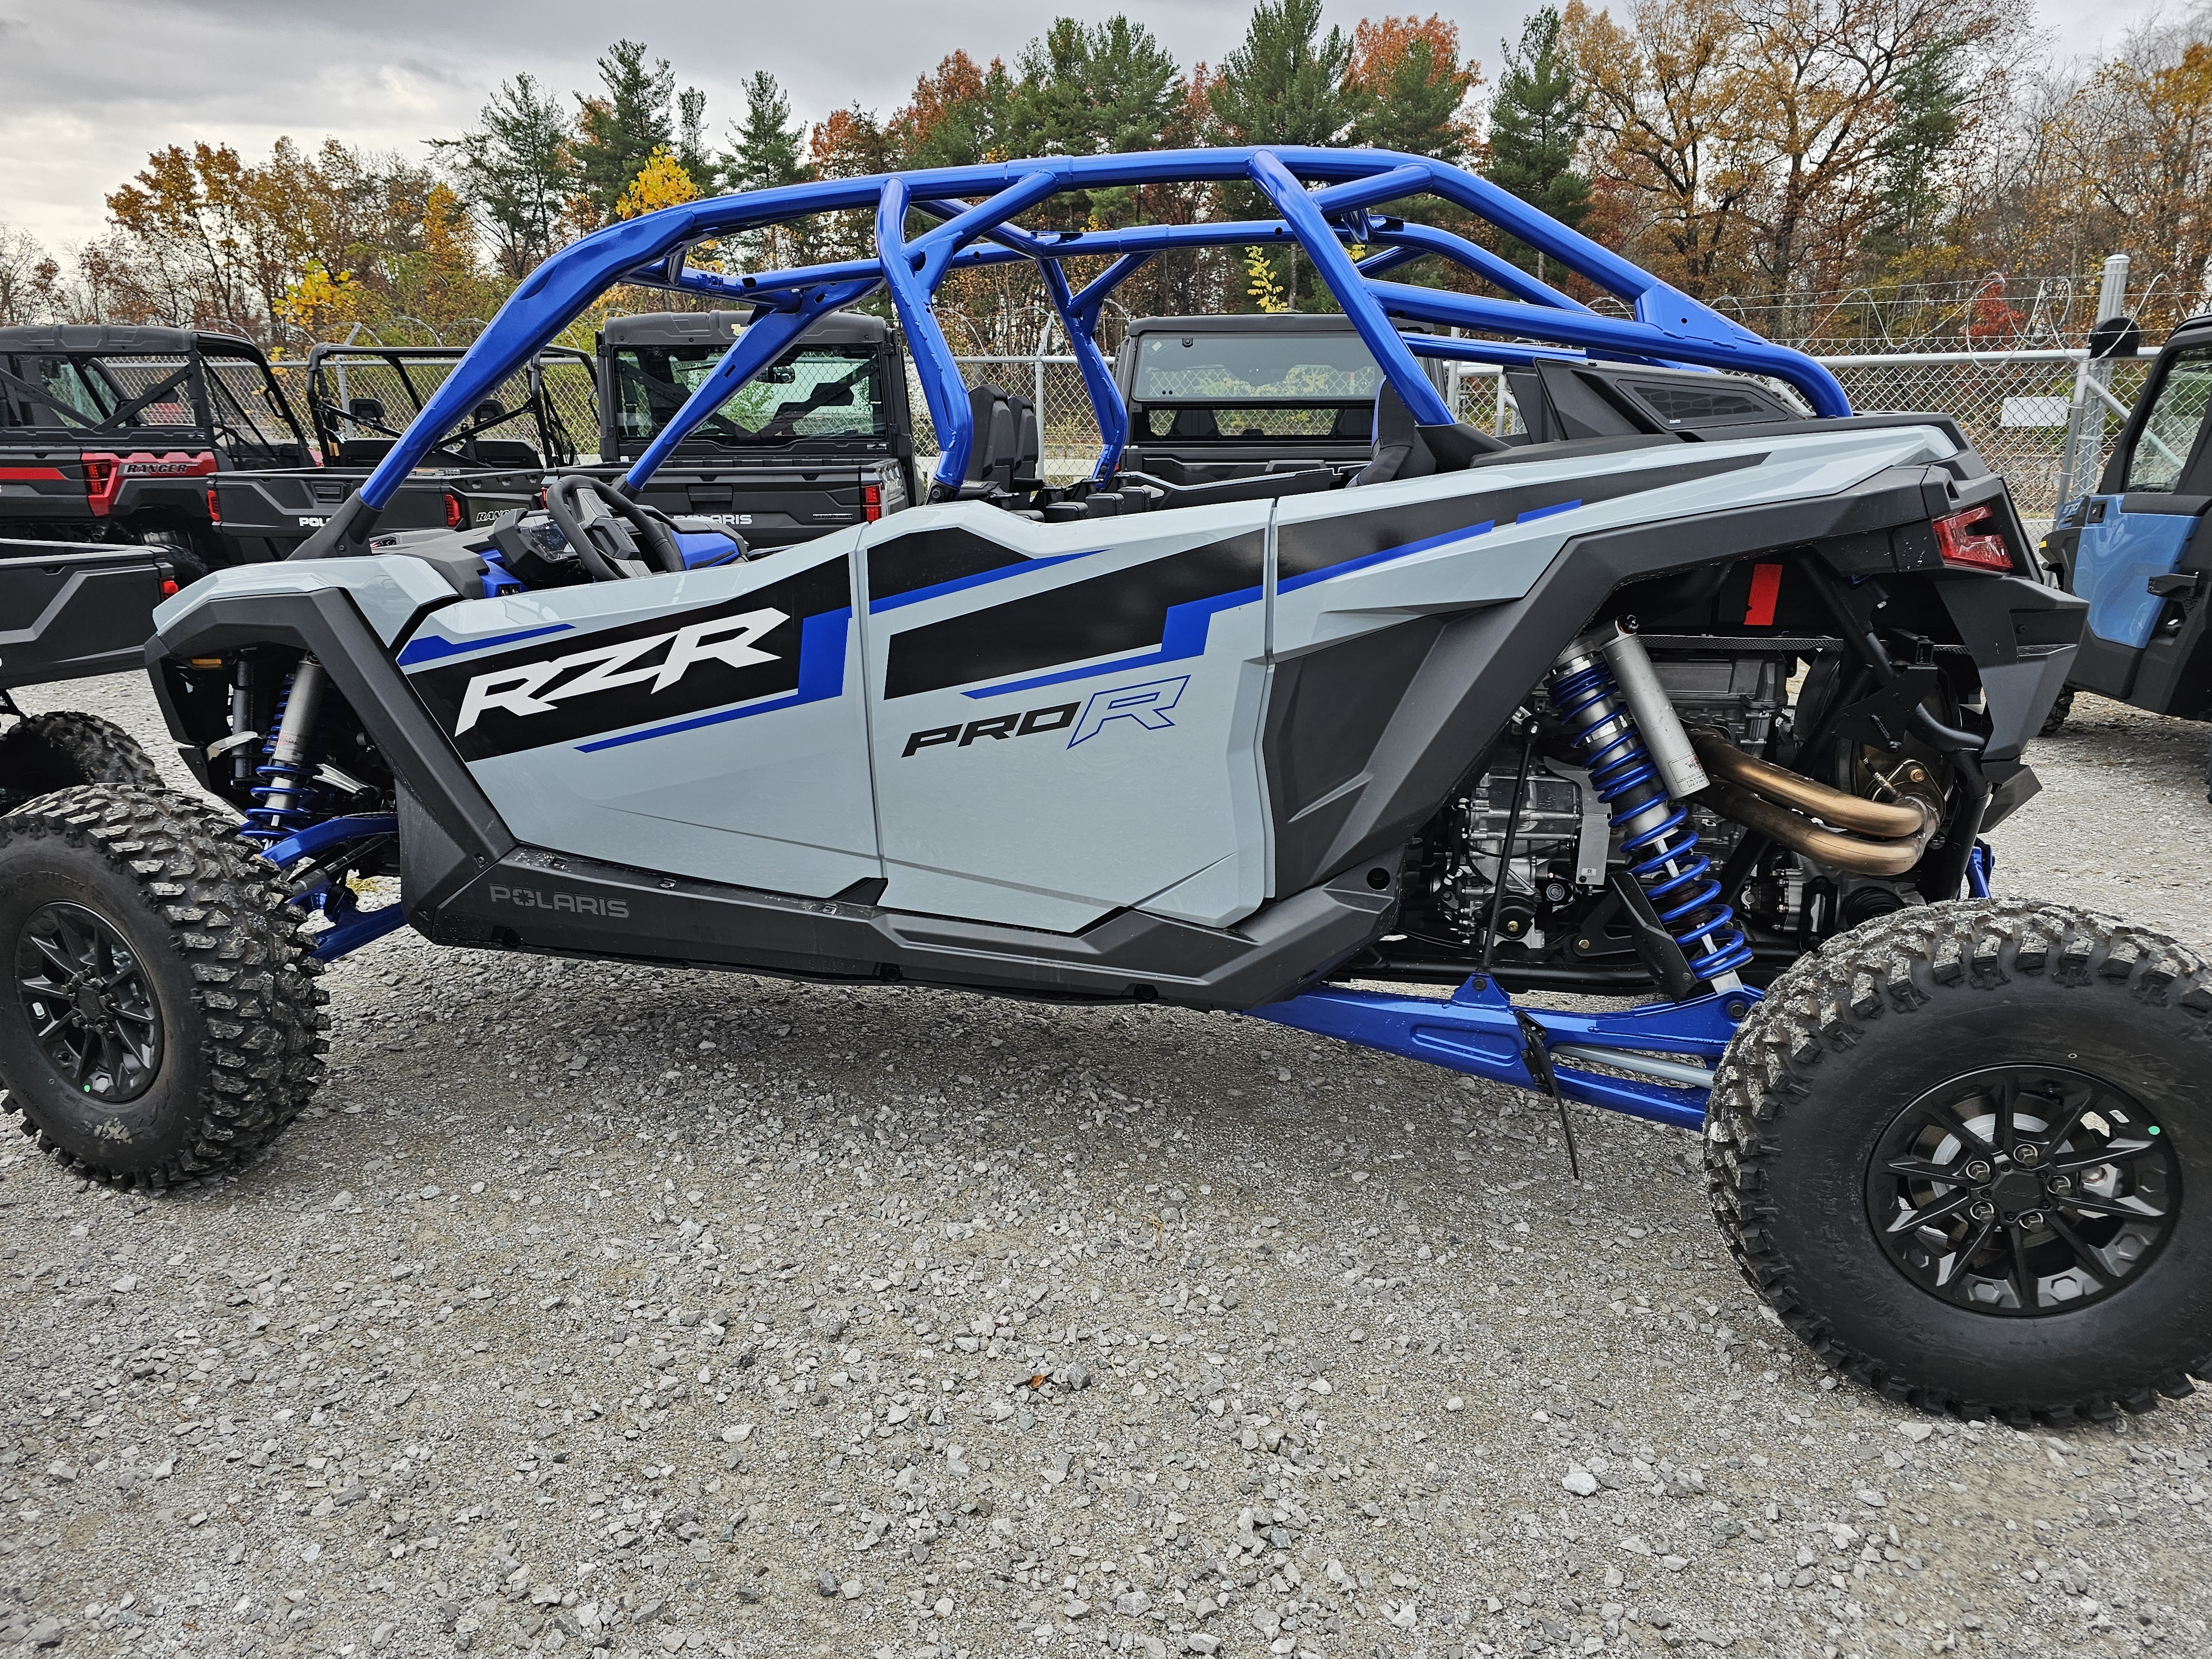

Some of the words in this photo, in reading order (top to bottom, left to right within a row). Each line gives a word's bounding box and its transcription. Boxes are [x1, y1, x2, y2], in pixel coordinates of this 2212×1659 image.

[127, 464, 187, 473] RANGER
[673, 514, 752, 525] ARIS
[455, 607, 791, 737] RZR
[901, 701, 1082, 758] PRO
[1066, 674, 1191, 750] R
[491, 885, 629, 918] POLARIS
